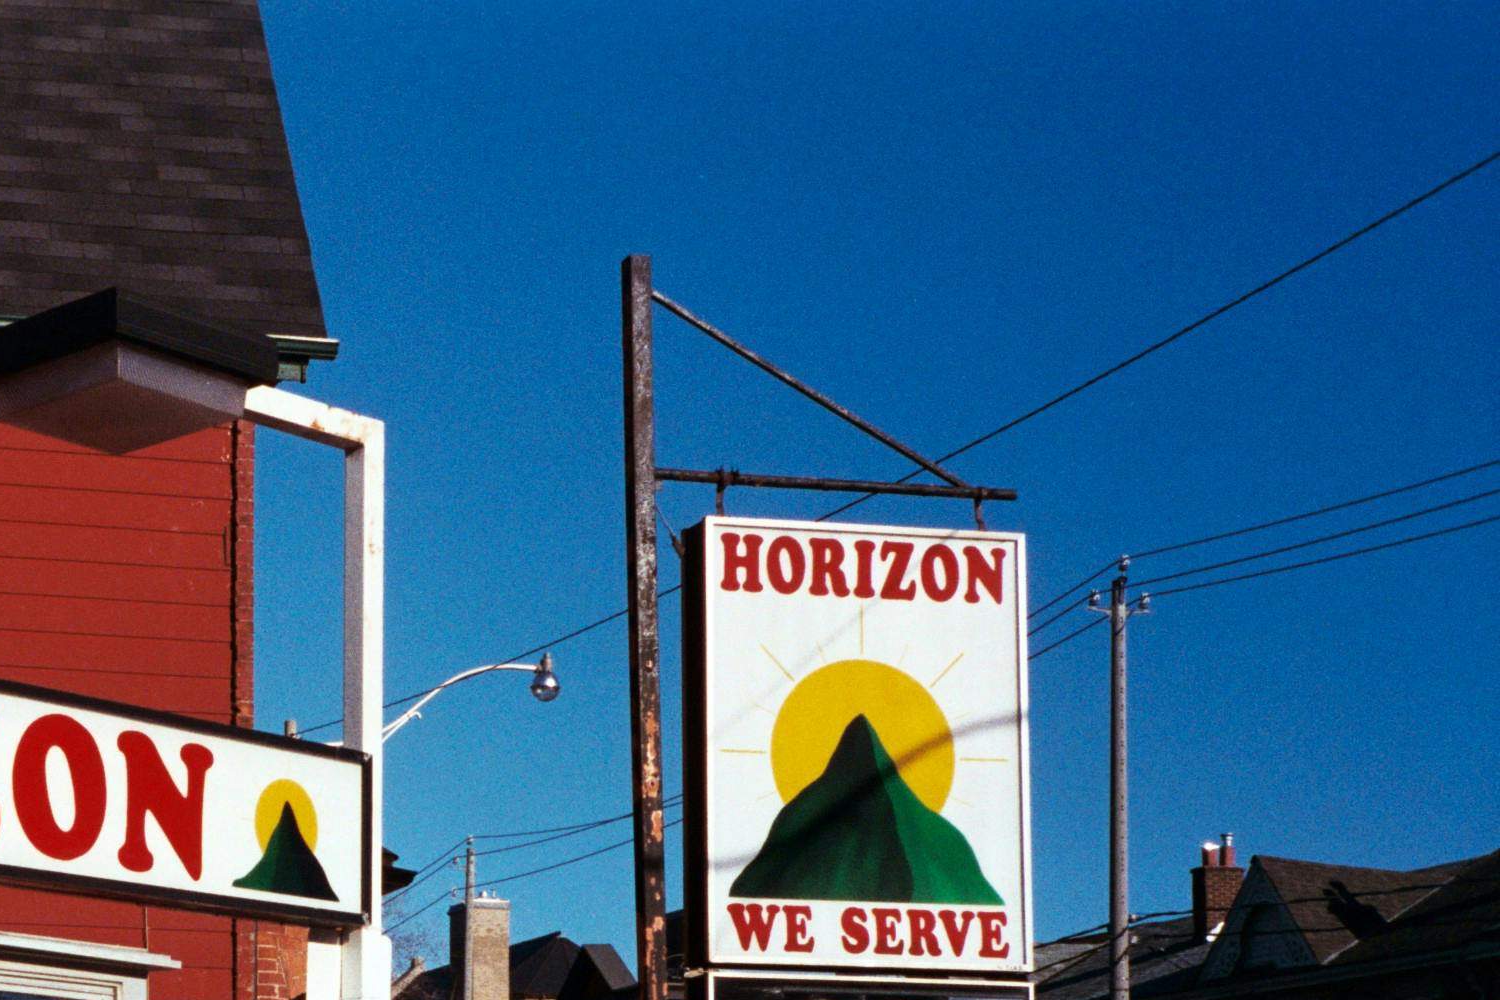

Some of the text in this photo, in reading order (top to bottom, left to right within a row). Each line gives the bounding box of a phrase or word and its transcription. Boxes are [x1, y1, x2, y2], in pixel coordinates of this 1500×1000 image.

[720, 532, 1007, 605] HORIZON
[726, 902, 1010, 959] WE SERVE
